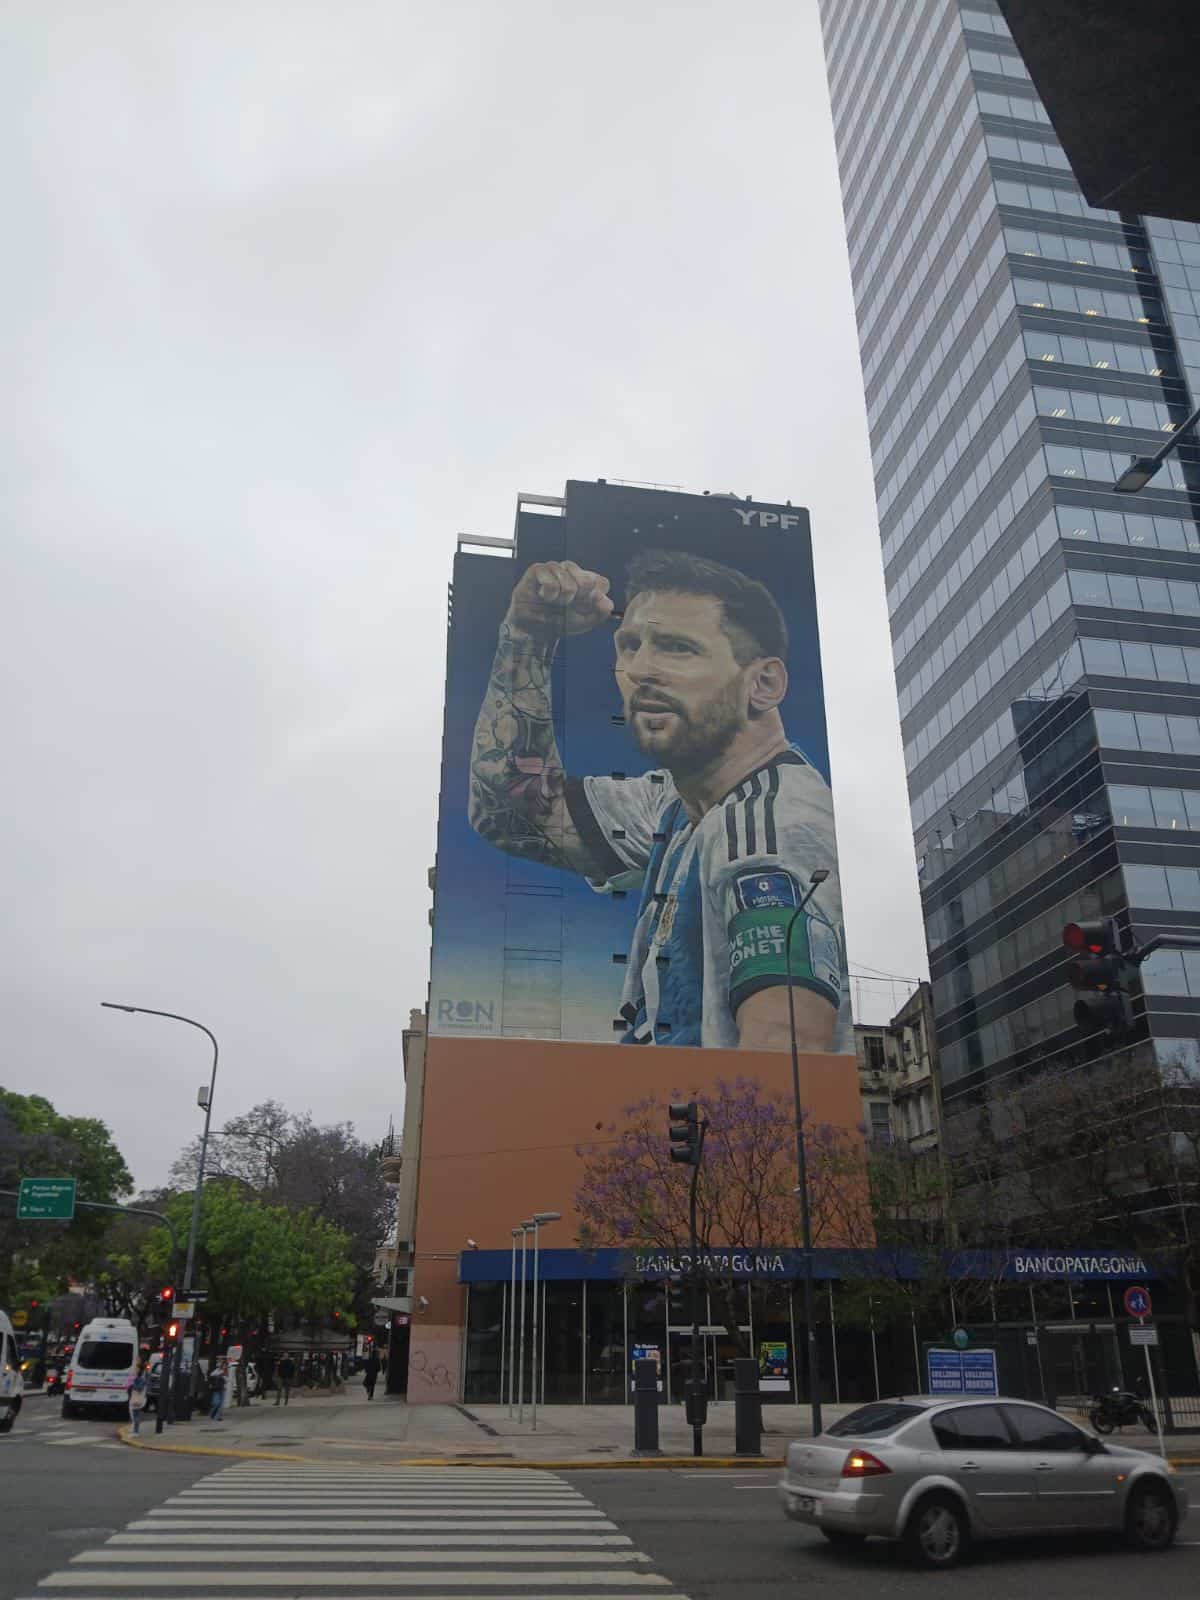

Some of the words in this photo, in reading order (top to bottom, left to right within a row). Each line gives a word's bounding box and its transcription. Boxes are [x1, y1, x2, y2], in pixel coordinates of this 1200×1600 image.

[733, 508, 800, 529] YPF
[745, 925, 785, 941] THE
[1015, 1256, 1147, 1273] BANCOPATAGONIA
